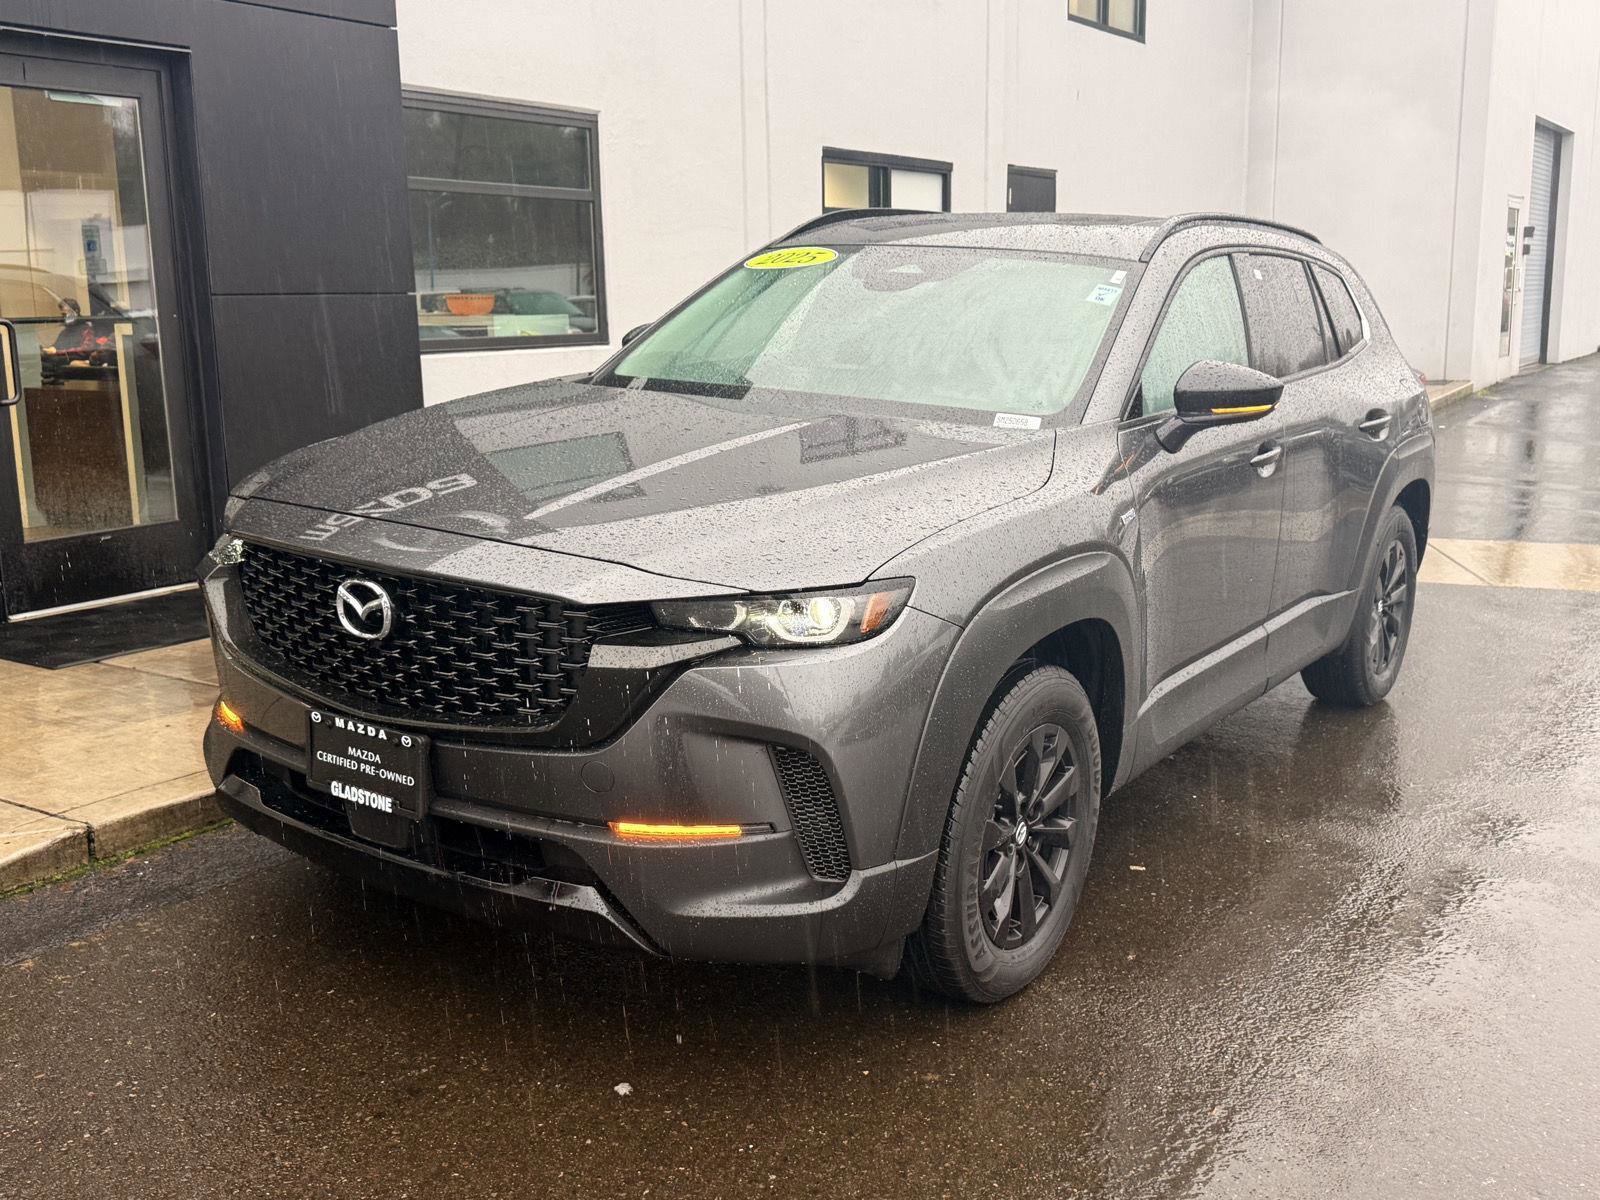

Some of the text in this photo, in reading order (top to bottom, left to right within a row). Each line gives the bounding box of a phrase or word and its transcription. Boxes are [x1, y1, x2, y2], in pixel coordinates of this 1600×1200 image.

[334, 717, 388, 740] MAZDA
[316, 750, 415, 786] CERTIFIED PRE-OWNED
[348, 746, 381, 764] MAZDA
[330, 780, 393, 813] GLADSTONE
